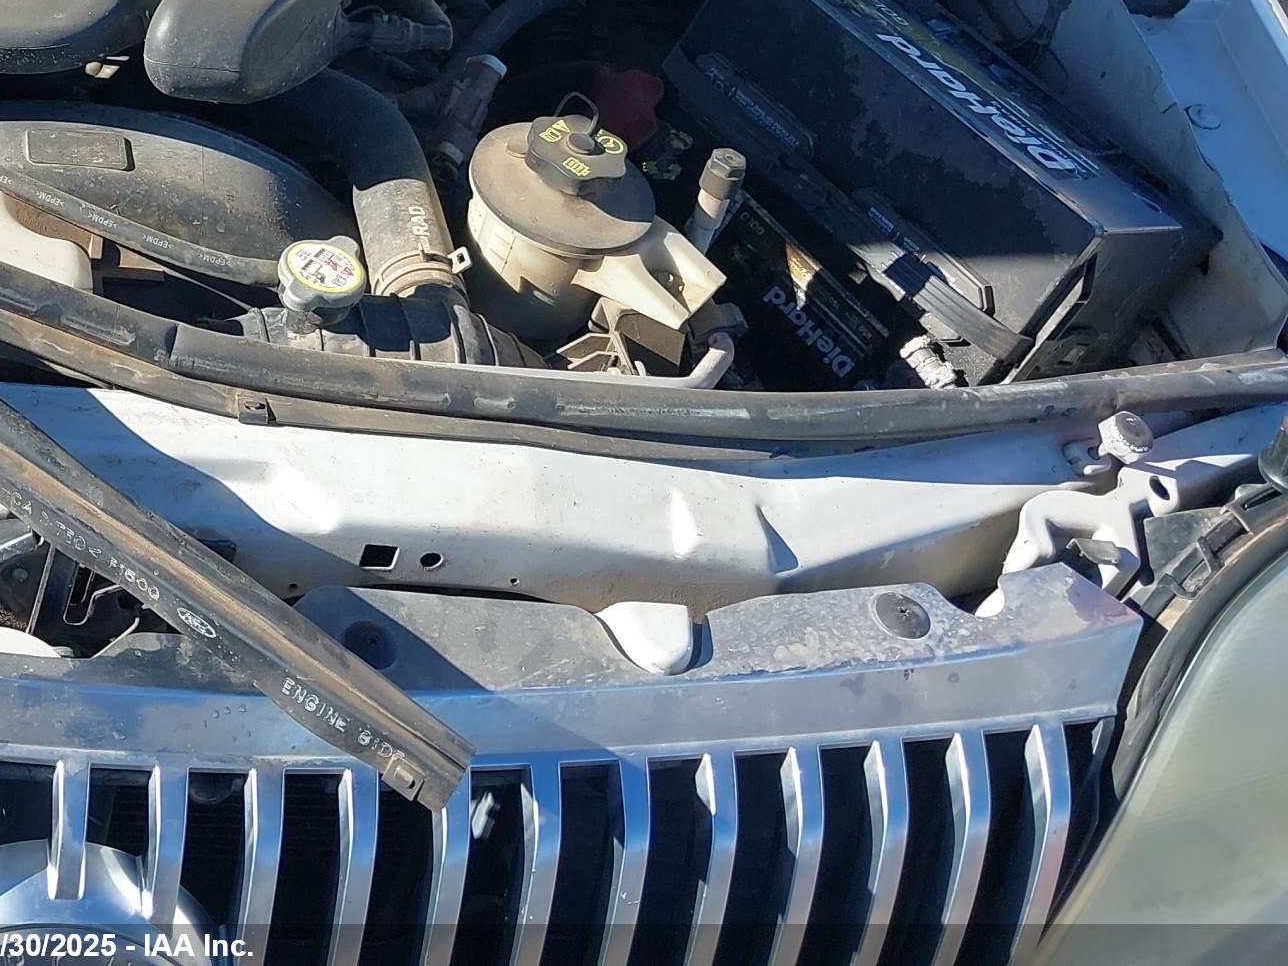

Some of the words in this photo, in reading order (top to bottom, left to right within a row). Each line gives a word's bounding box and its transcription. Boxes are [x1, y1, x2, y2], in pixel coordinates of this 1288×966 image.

[876, 33, 1076, 170] DieHard
[762, 285, 857, 378] DieHard
[281, 677, 346, 732] ENGINE
